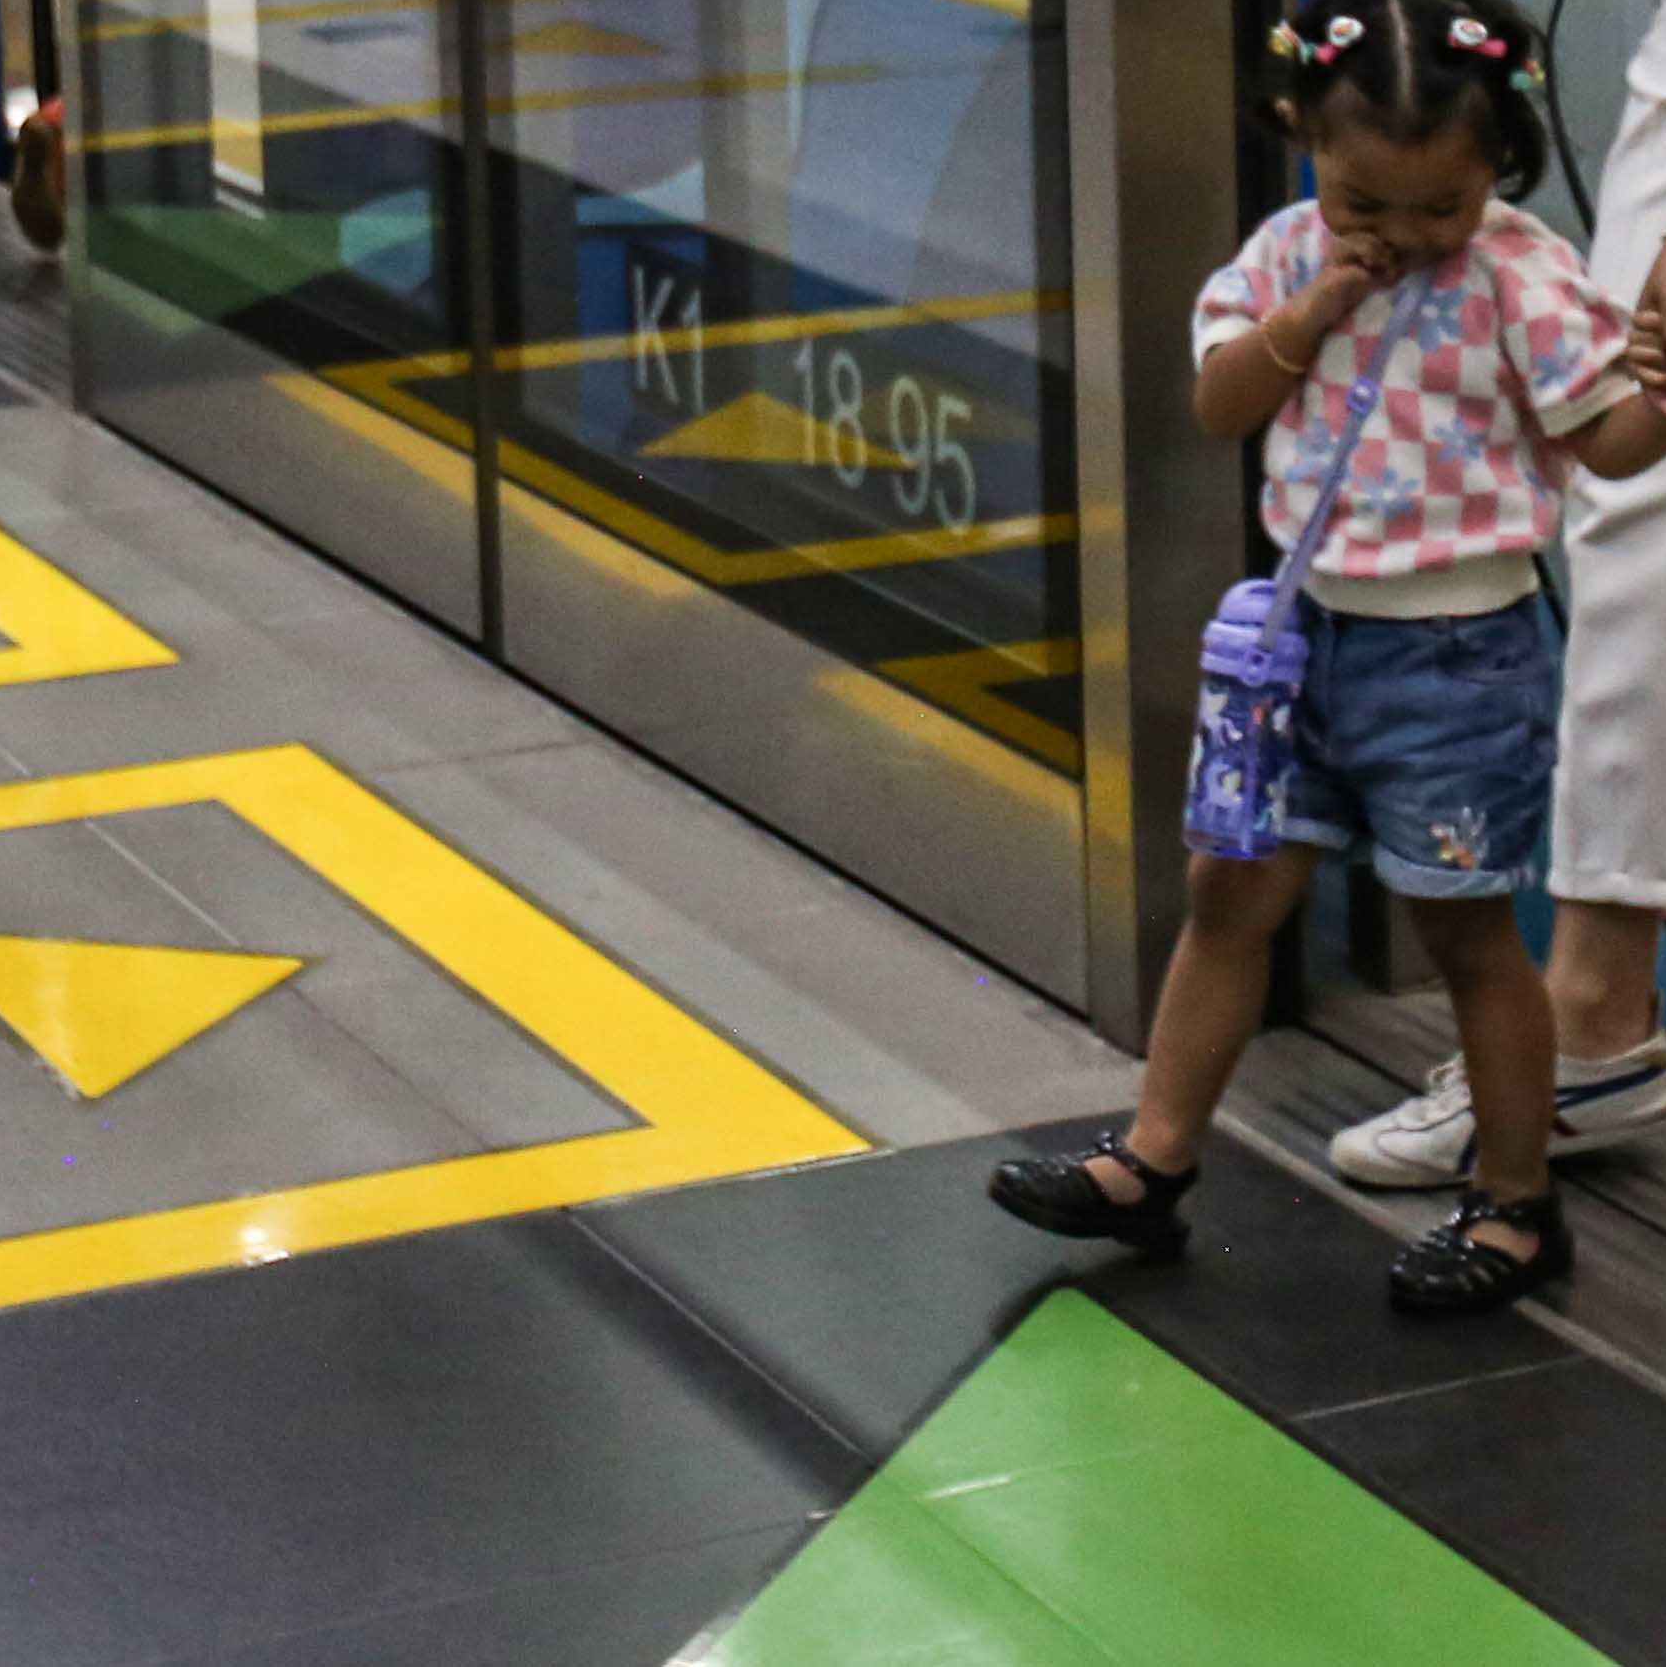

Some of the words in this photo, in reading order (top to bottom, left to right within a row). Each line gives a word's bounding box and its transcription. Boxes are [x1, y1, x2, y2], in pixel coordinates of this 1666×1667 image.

[634, 265, 705, 416] K1
[793, 337, 869, 490] 18
[889, 375, 977, 535] 95
